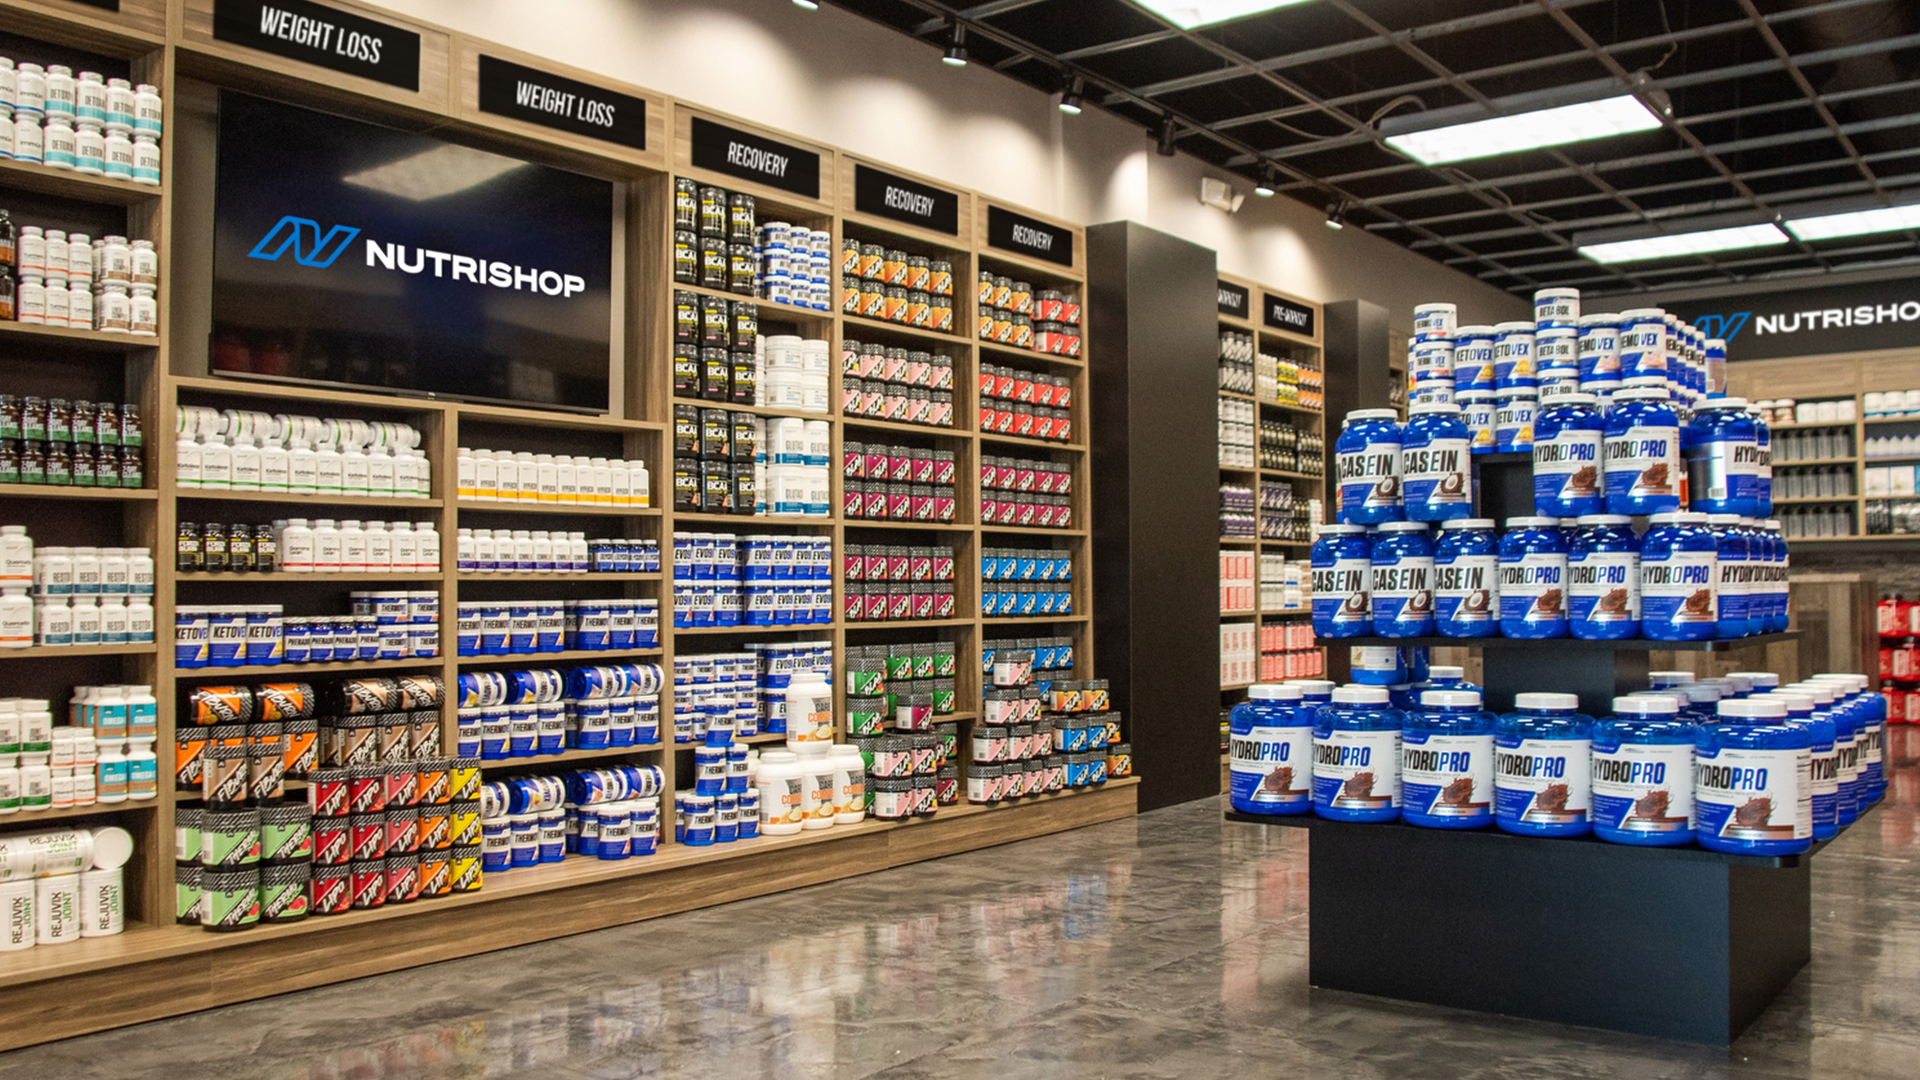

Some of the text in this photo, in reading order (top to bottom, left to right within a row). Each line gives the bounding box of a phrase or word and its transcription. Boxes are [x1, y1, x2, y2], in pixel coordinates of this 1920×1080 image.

[260, 5, 383, 65] WEIGHT LOSS
[515, 80, 615, 130] WEIGHT LOSS
[727, 141, 789, 178] RECOVERY
[885, 185, 935, 218] RECOVERY
[1012, 224, 1054, 252] RECOVERY
[365, 238, 586, 299] NUTRISHOP
[1754, 300, 1920, 336] NUTRISHO
[1579, 337, 1616, 352] EMOVEX
[1621, 332, 1659, 349] EMOVEX
[29, 833, 78, 846] REJUVIX
[24, 896, 32, 928] JOINT
[51, 891, 62, 938] REJUVIX
[62, 891, 72, 922] JOINT
[99, 884, 110, 930] REJUVIX
[110, 885, 119, 915] JOINT
[12, 896, 23, 944] REJUVIX
